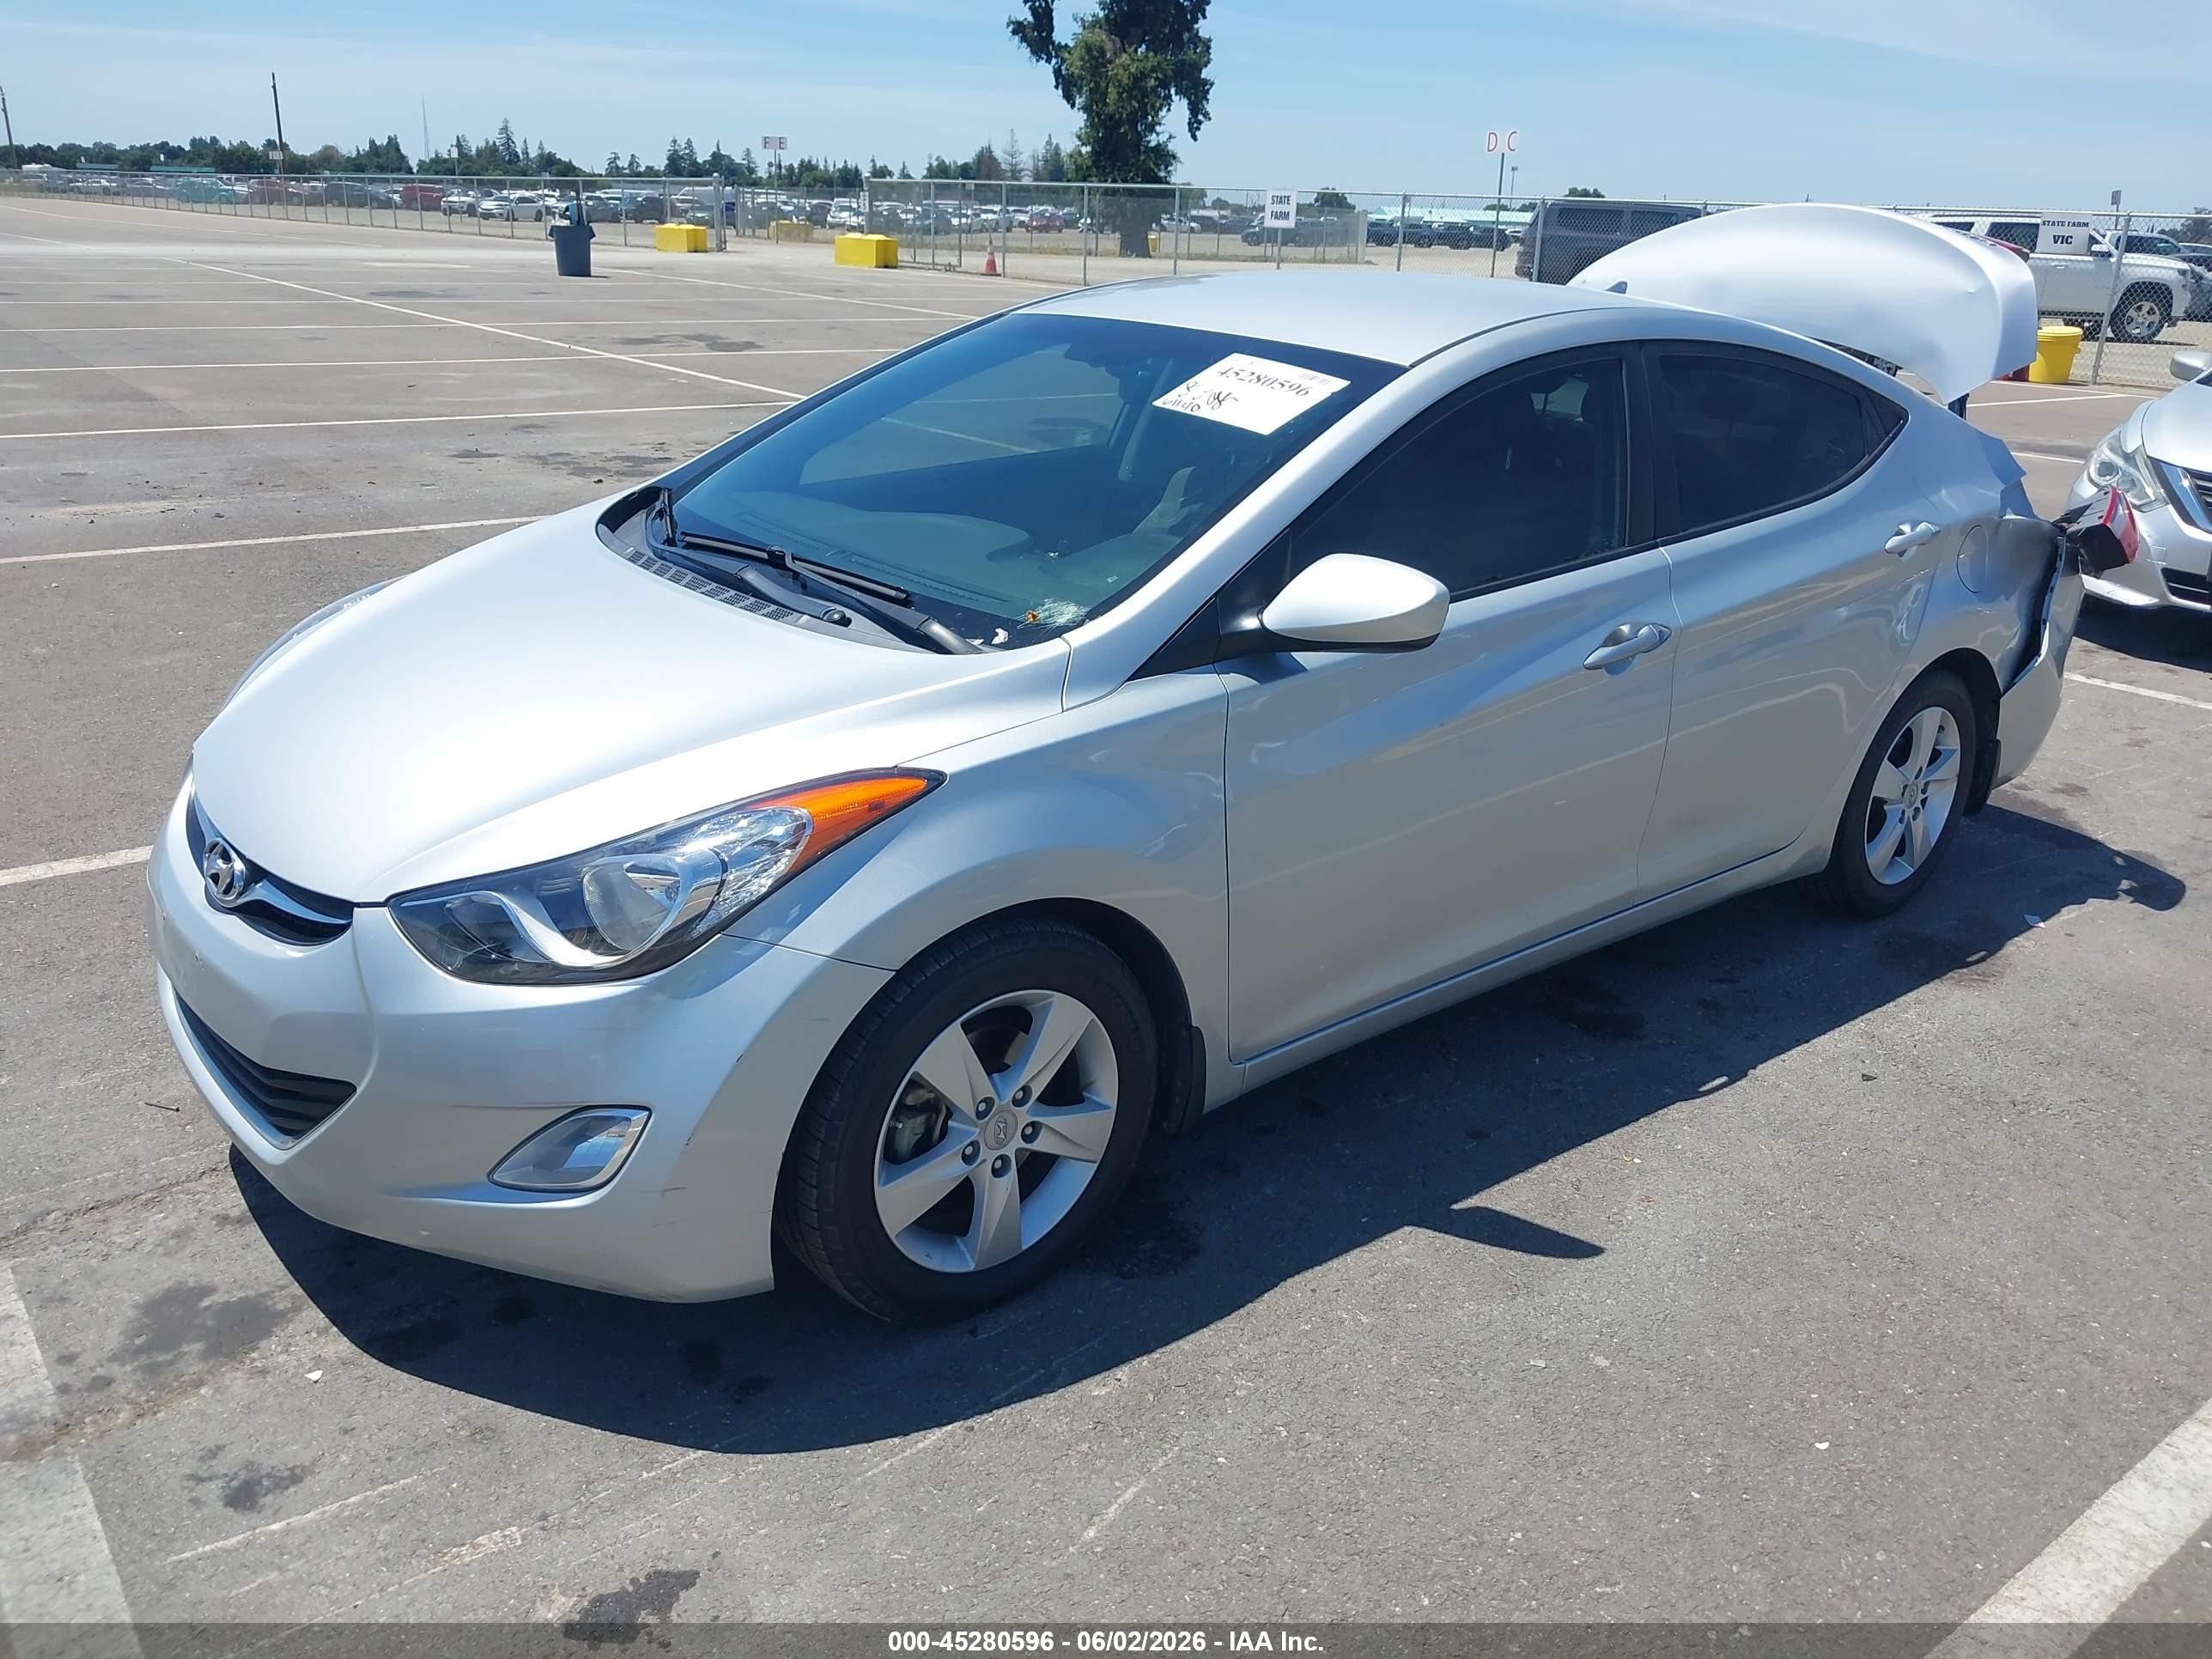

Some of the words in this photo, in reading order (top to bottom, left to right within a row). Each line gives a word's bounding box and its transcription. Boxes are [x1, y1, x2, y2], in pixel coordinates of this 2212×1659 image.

[1487, 131, 1498, 152] D
[1507, 131, 1518, 152] C
[1270, 194, 1292, 205] STATE
[1270, 210, 1290, 221] FARM
[2052, 234, 2074, 245] VIC
[1218, 367, 1311, 398] 45280596
